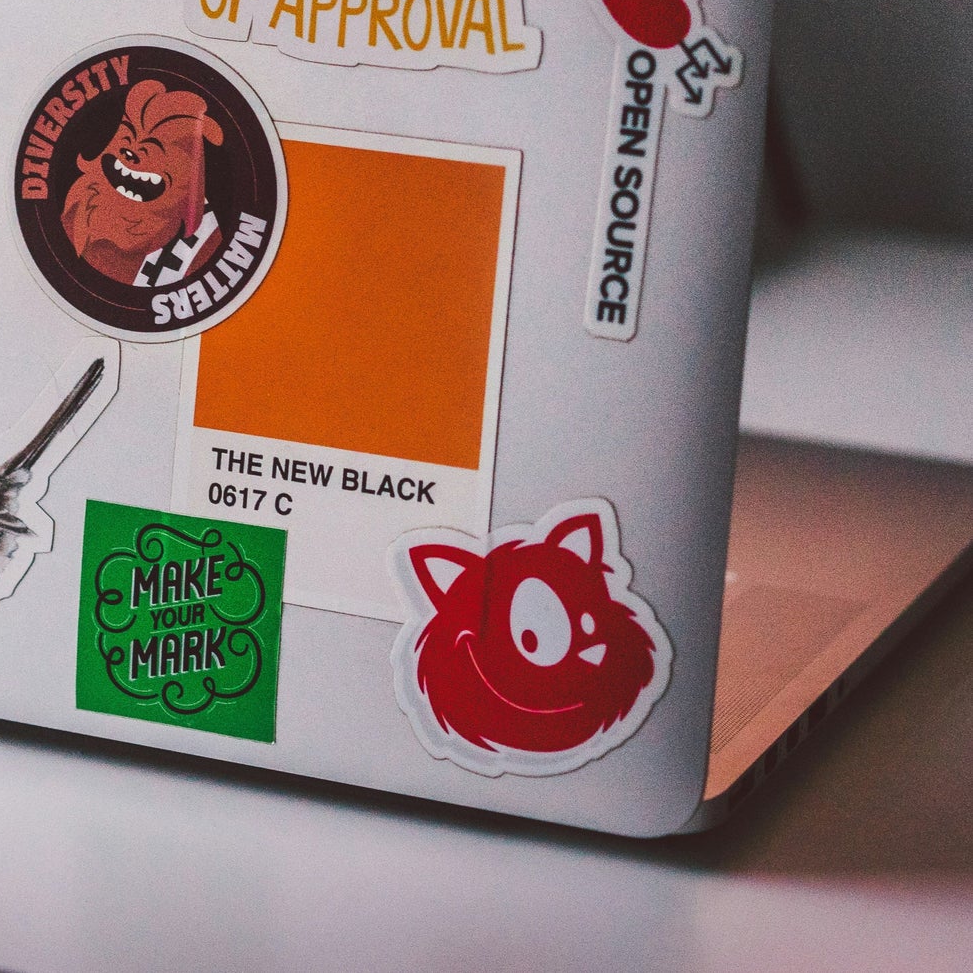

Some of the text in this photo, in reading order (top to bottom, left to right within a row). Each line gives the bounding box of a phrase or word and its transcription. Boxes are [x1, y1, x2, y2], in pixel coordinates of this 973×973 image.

[21, 54, 130, 200] DIVERSITY
[617, 49, 657, 158] OPEN
[151, 211, 268, 325] MATTERS
[596, 165, 644, 325] SOURCE
[208, 483, 293, 516] 0617 C
[211, 447, 437, 505] THE NEW BLACK
[130, 554, 226, 610] MAKE
[149, 602, 206, 630] YOUR
[128, 626, 228, 681] MARK
